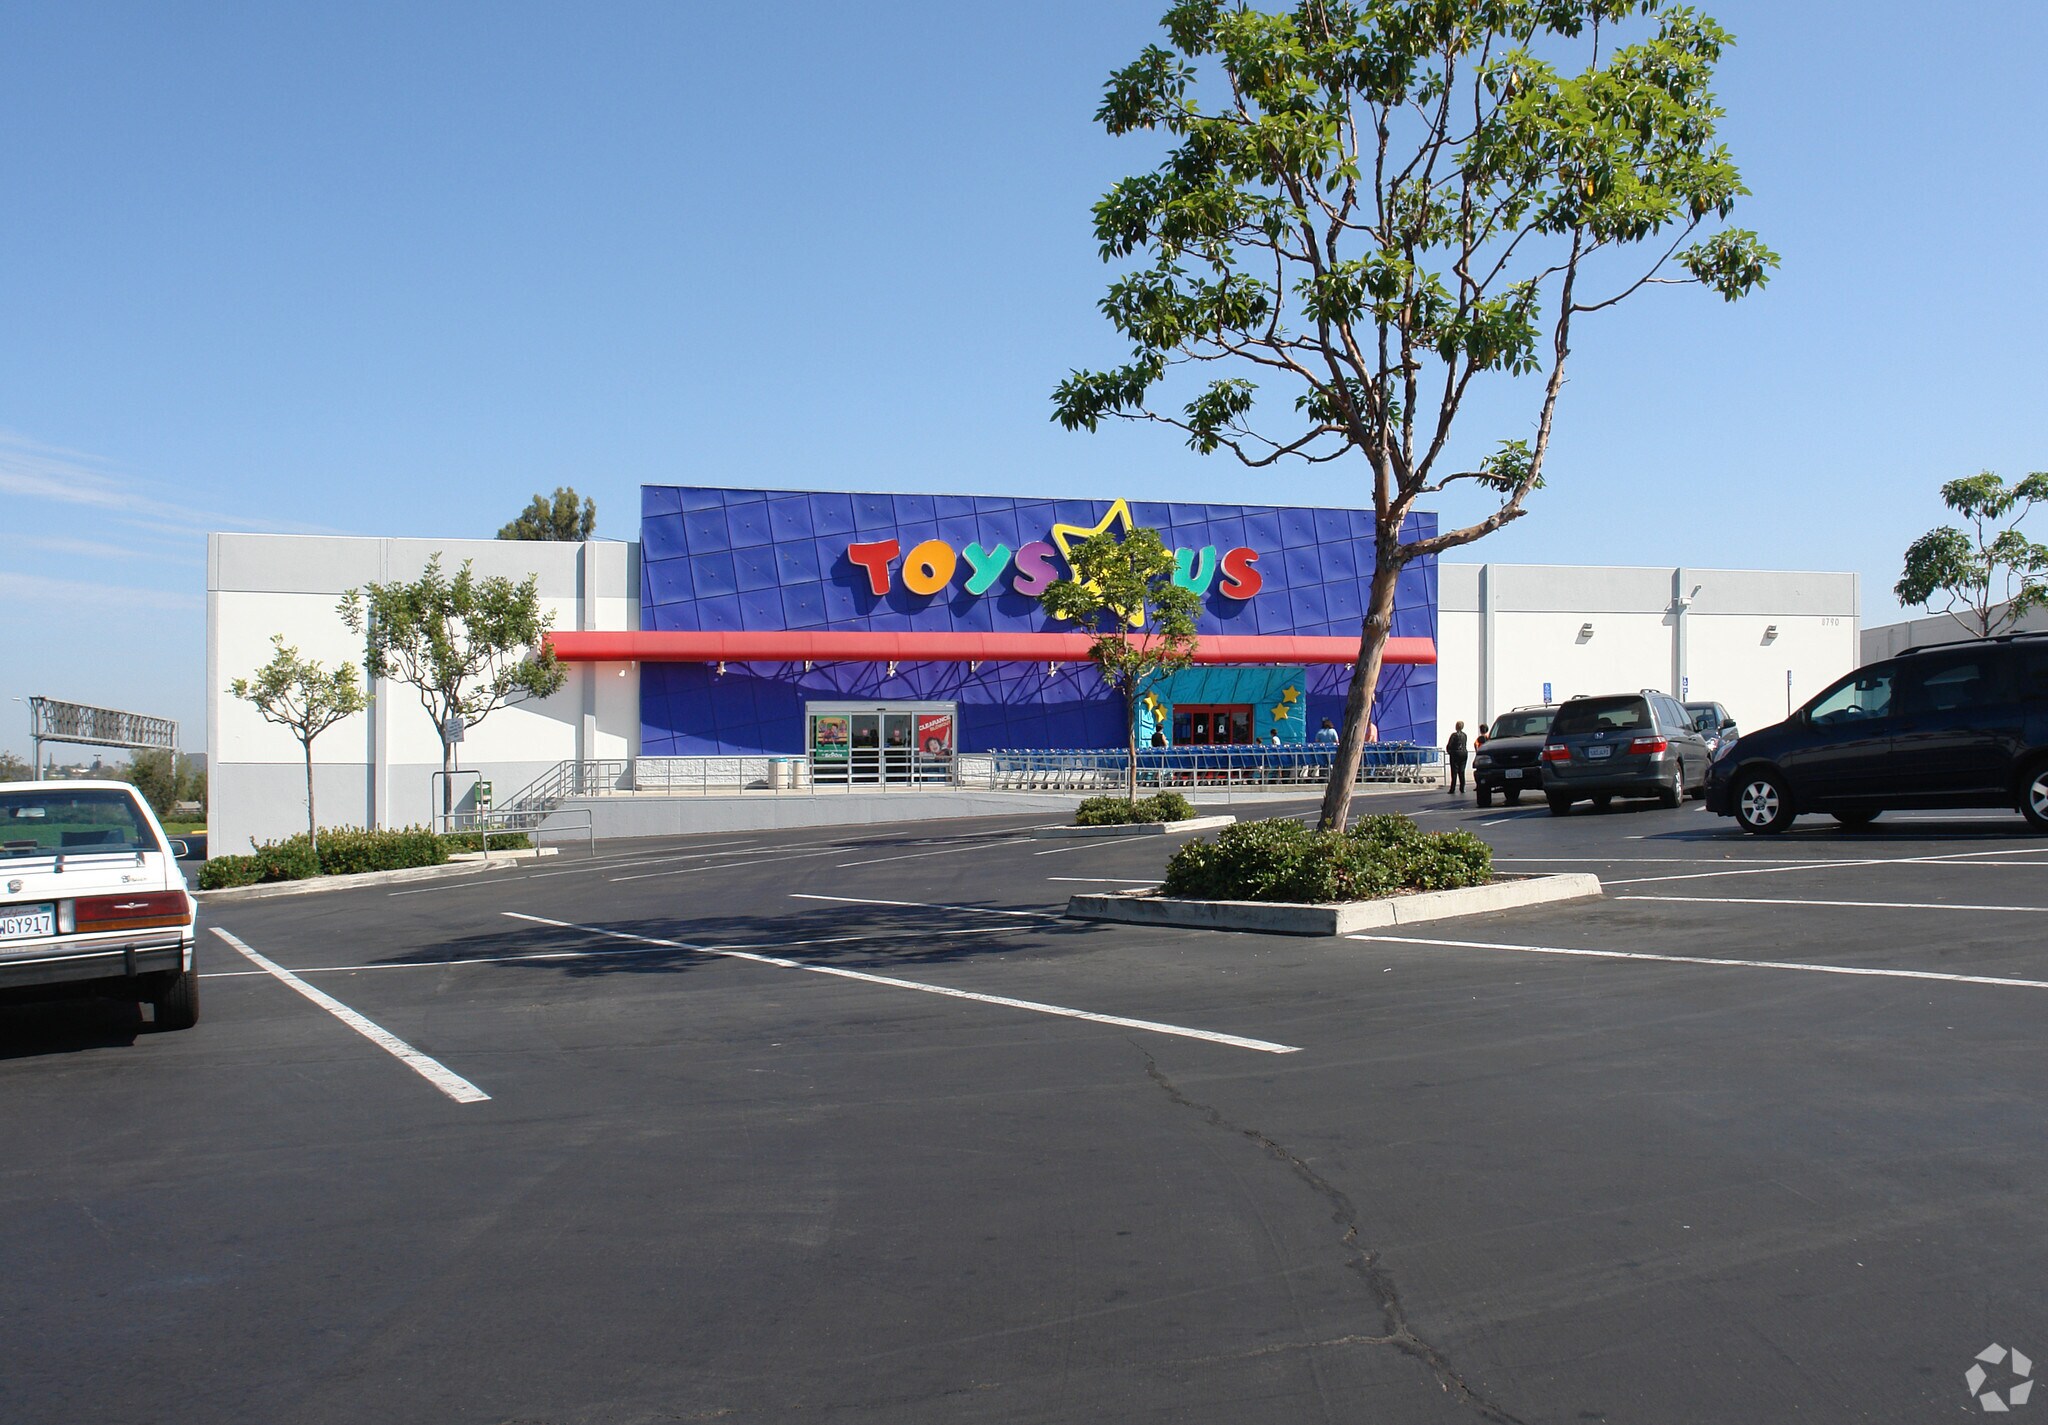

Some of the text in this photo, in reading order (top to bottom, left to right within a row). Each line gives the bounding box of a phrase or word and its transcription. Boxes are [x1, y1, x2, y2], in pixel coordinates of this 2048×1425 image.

[848, 538, 1059, 596] TOYS
[1172, 545, 1264, 600] US
[1821, 617, 1840, 626] 8790
[0, 908, 38, 918] alifornia
